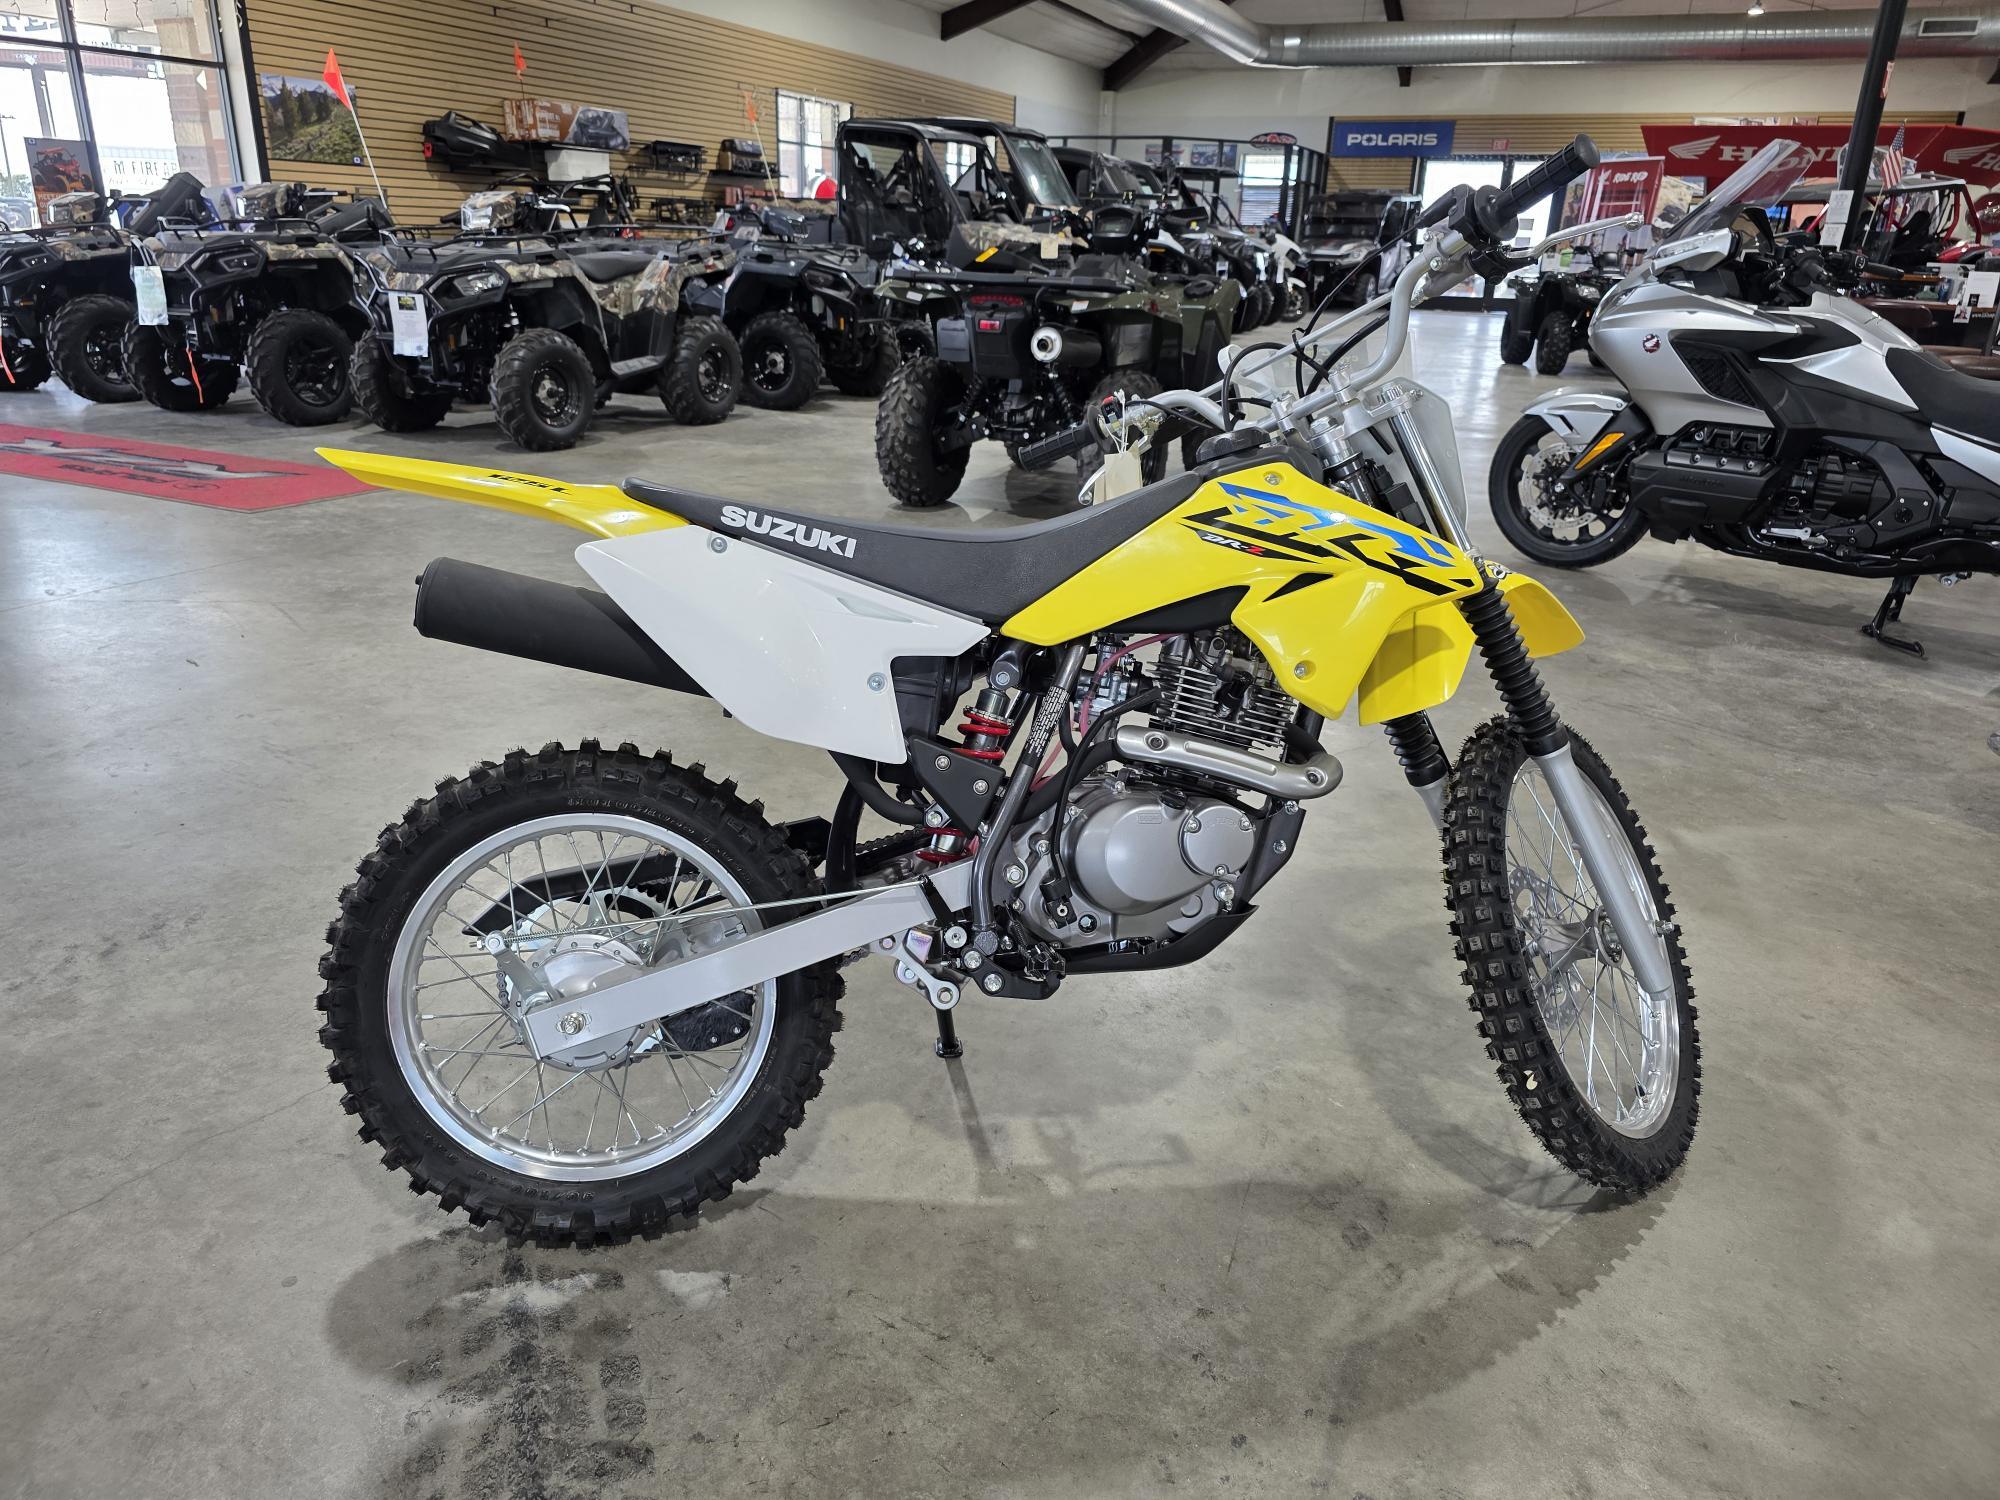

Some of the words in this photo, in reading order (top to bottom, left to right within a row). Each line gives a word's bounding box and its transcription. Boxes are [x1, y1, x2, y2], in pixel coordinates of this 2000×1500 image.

[1347, 133, 1438, 146] POLARIS
[1630, 171, 1649, 183] RED
[720, 505, 857, 558] SUZUKI
[1201, 533, 1266, 556] DR-Z
